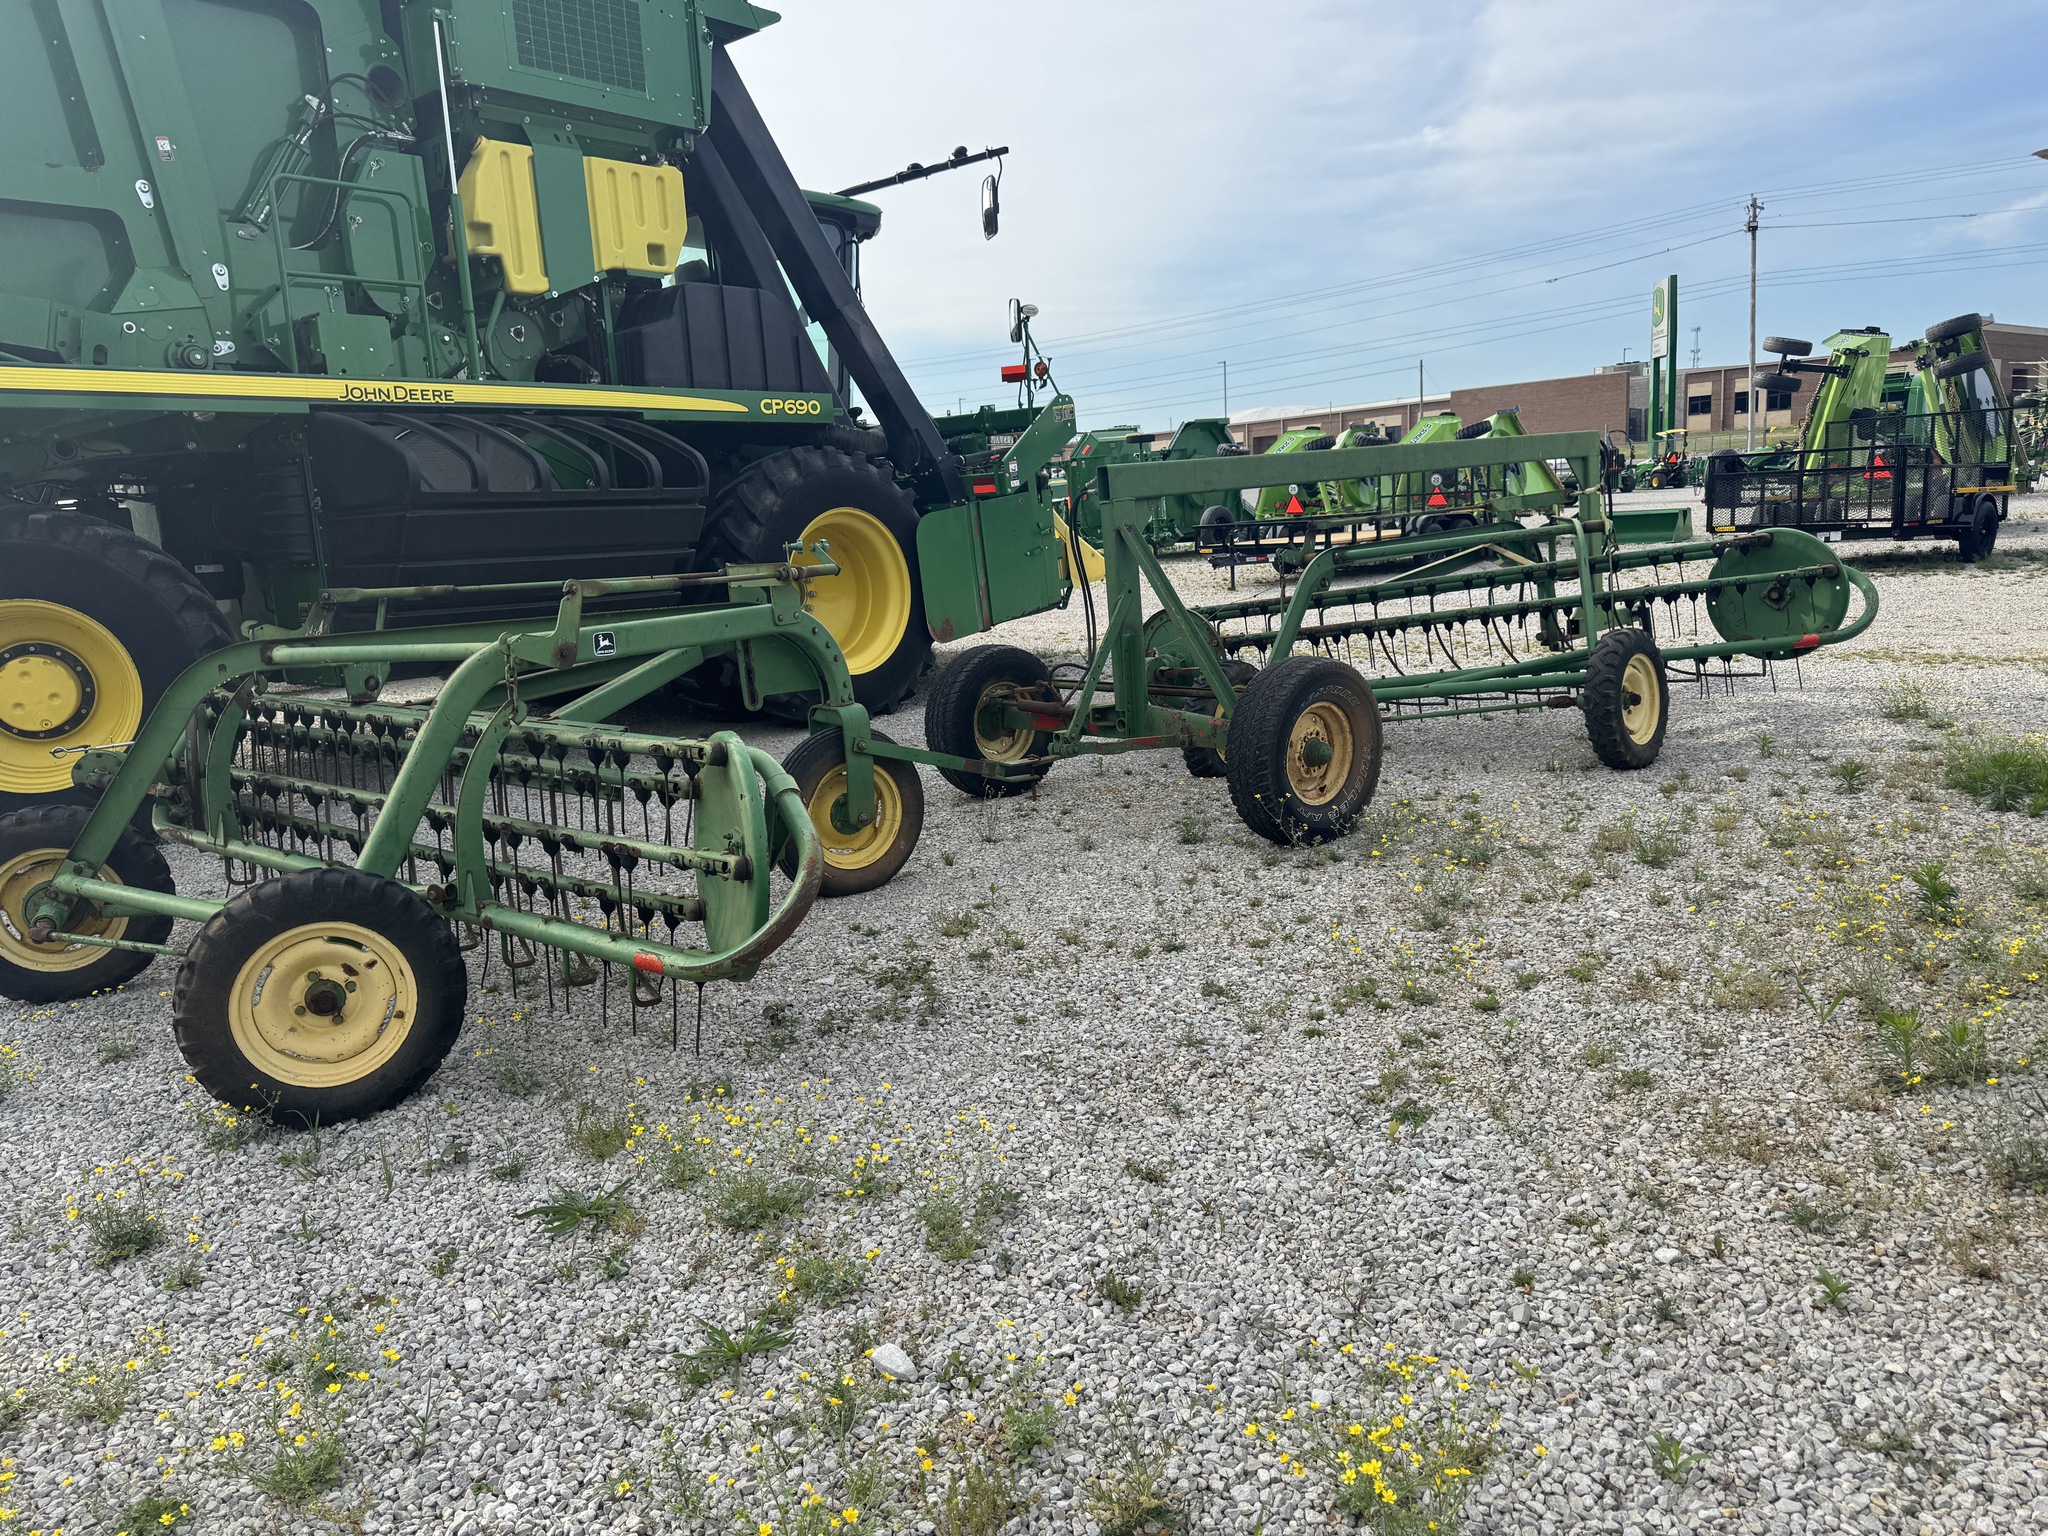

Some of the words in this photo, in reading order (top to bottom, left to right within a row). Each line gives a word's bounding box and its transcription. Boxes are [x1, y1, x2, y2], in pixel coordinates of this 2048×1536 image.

[339, 384, 391, 401] JOHN
[393, 385, 455, 402] DEERE
[760, 398, 821, 415] CP690
